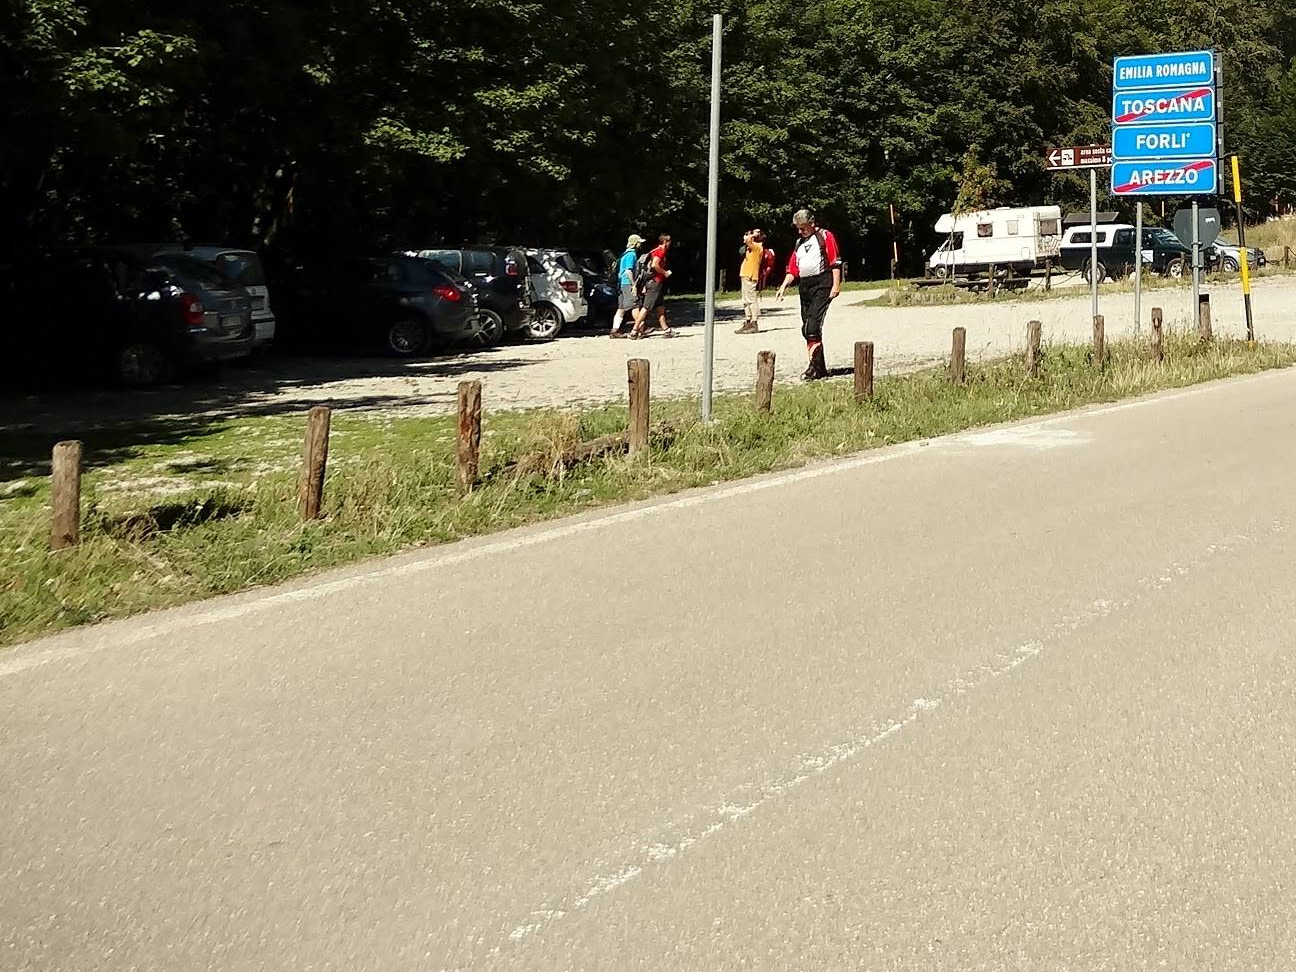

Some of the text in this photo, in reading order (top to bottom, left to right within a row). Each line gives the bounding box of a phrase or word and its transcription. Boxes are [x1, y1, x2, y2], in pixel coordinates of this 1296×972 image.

[1119, 62, 1207, 80] EMILIA ROMAGNA
[1122, 96, 1205, 115] TOSCANA
[1136, 133, 1191, 150] FORLI'
[1129, 168, 1198, 185] AREZZO
